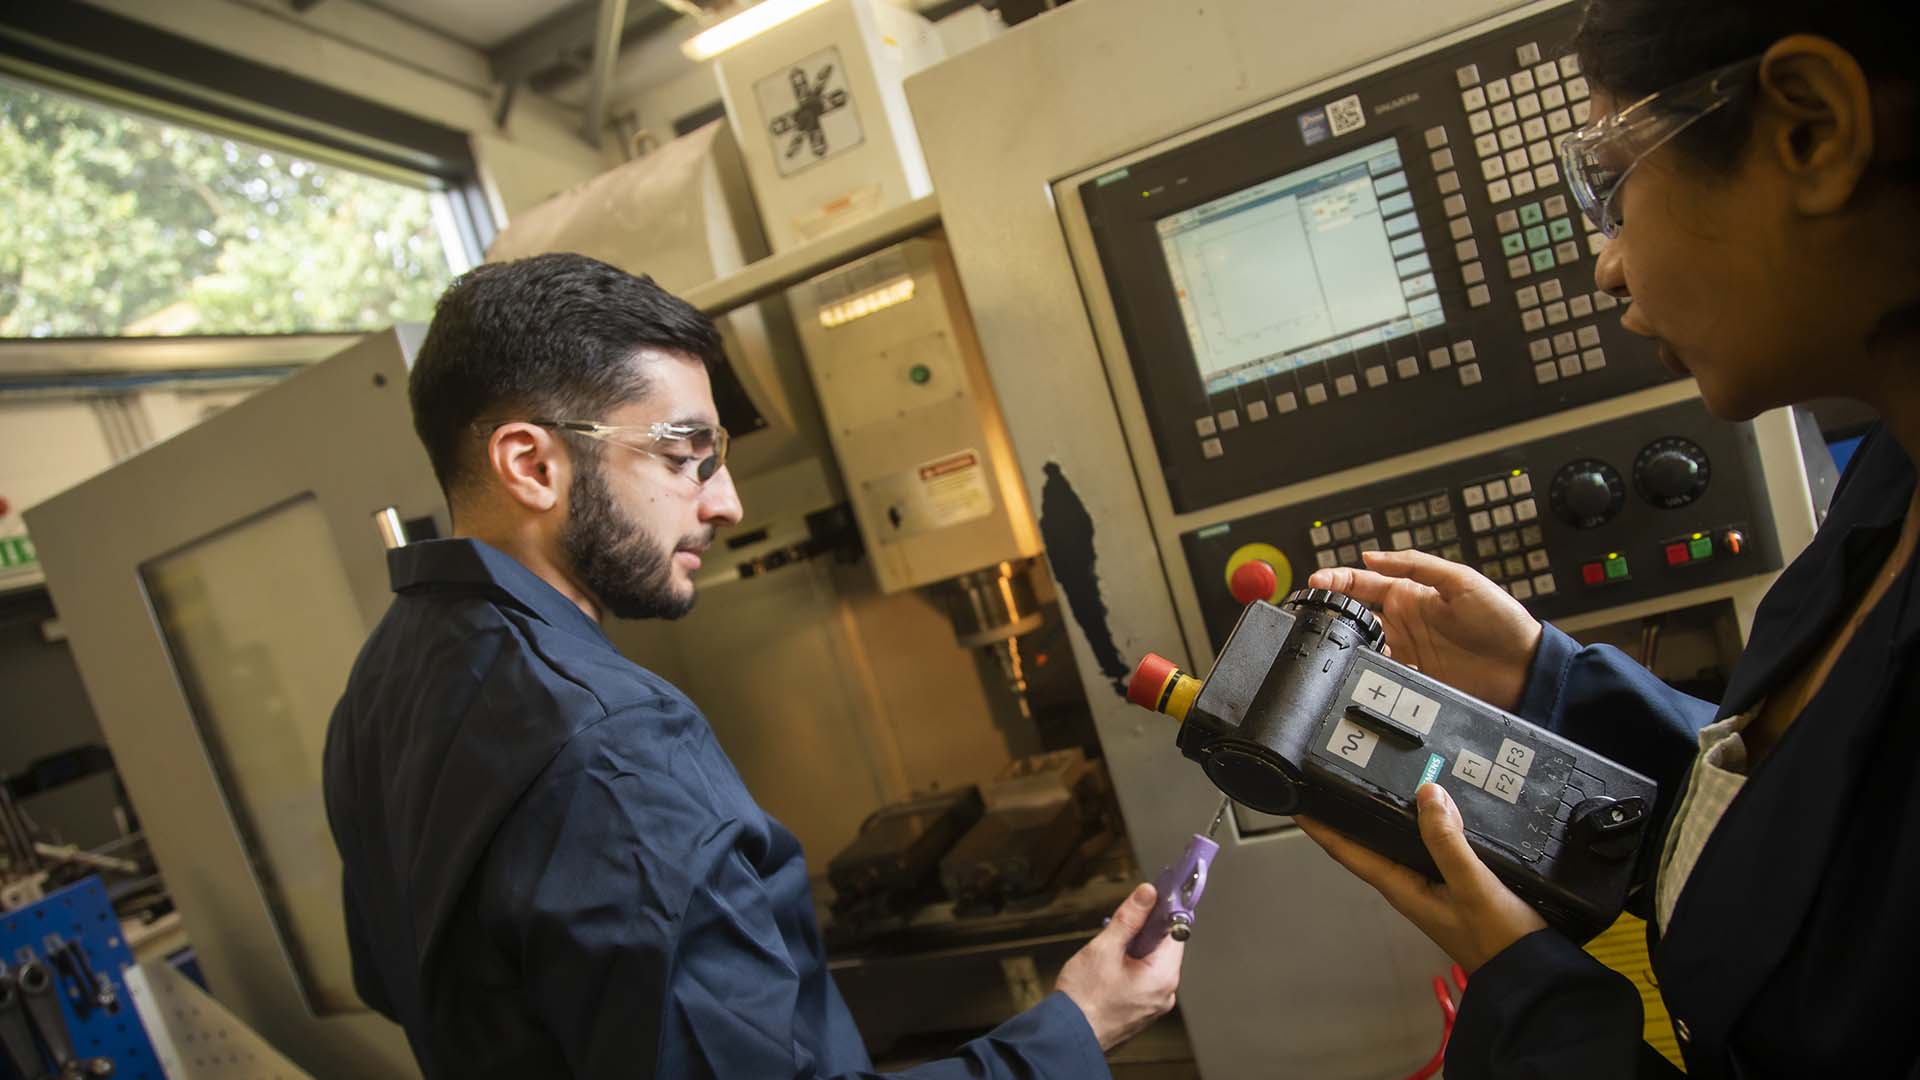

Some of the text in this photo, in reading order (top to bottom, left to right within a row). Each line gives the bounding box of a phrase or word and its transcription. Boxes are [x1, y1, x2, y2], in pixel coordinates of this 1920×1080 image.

[1506, 747, 1525, 768] F3
[1424, 757, 1441, 784] MENS
[1462, 759, 1481, 779] F1
[1495, 773, 1515, 794] F2
[1534, 806, 1546, 816] X
